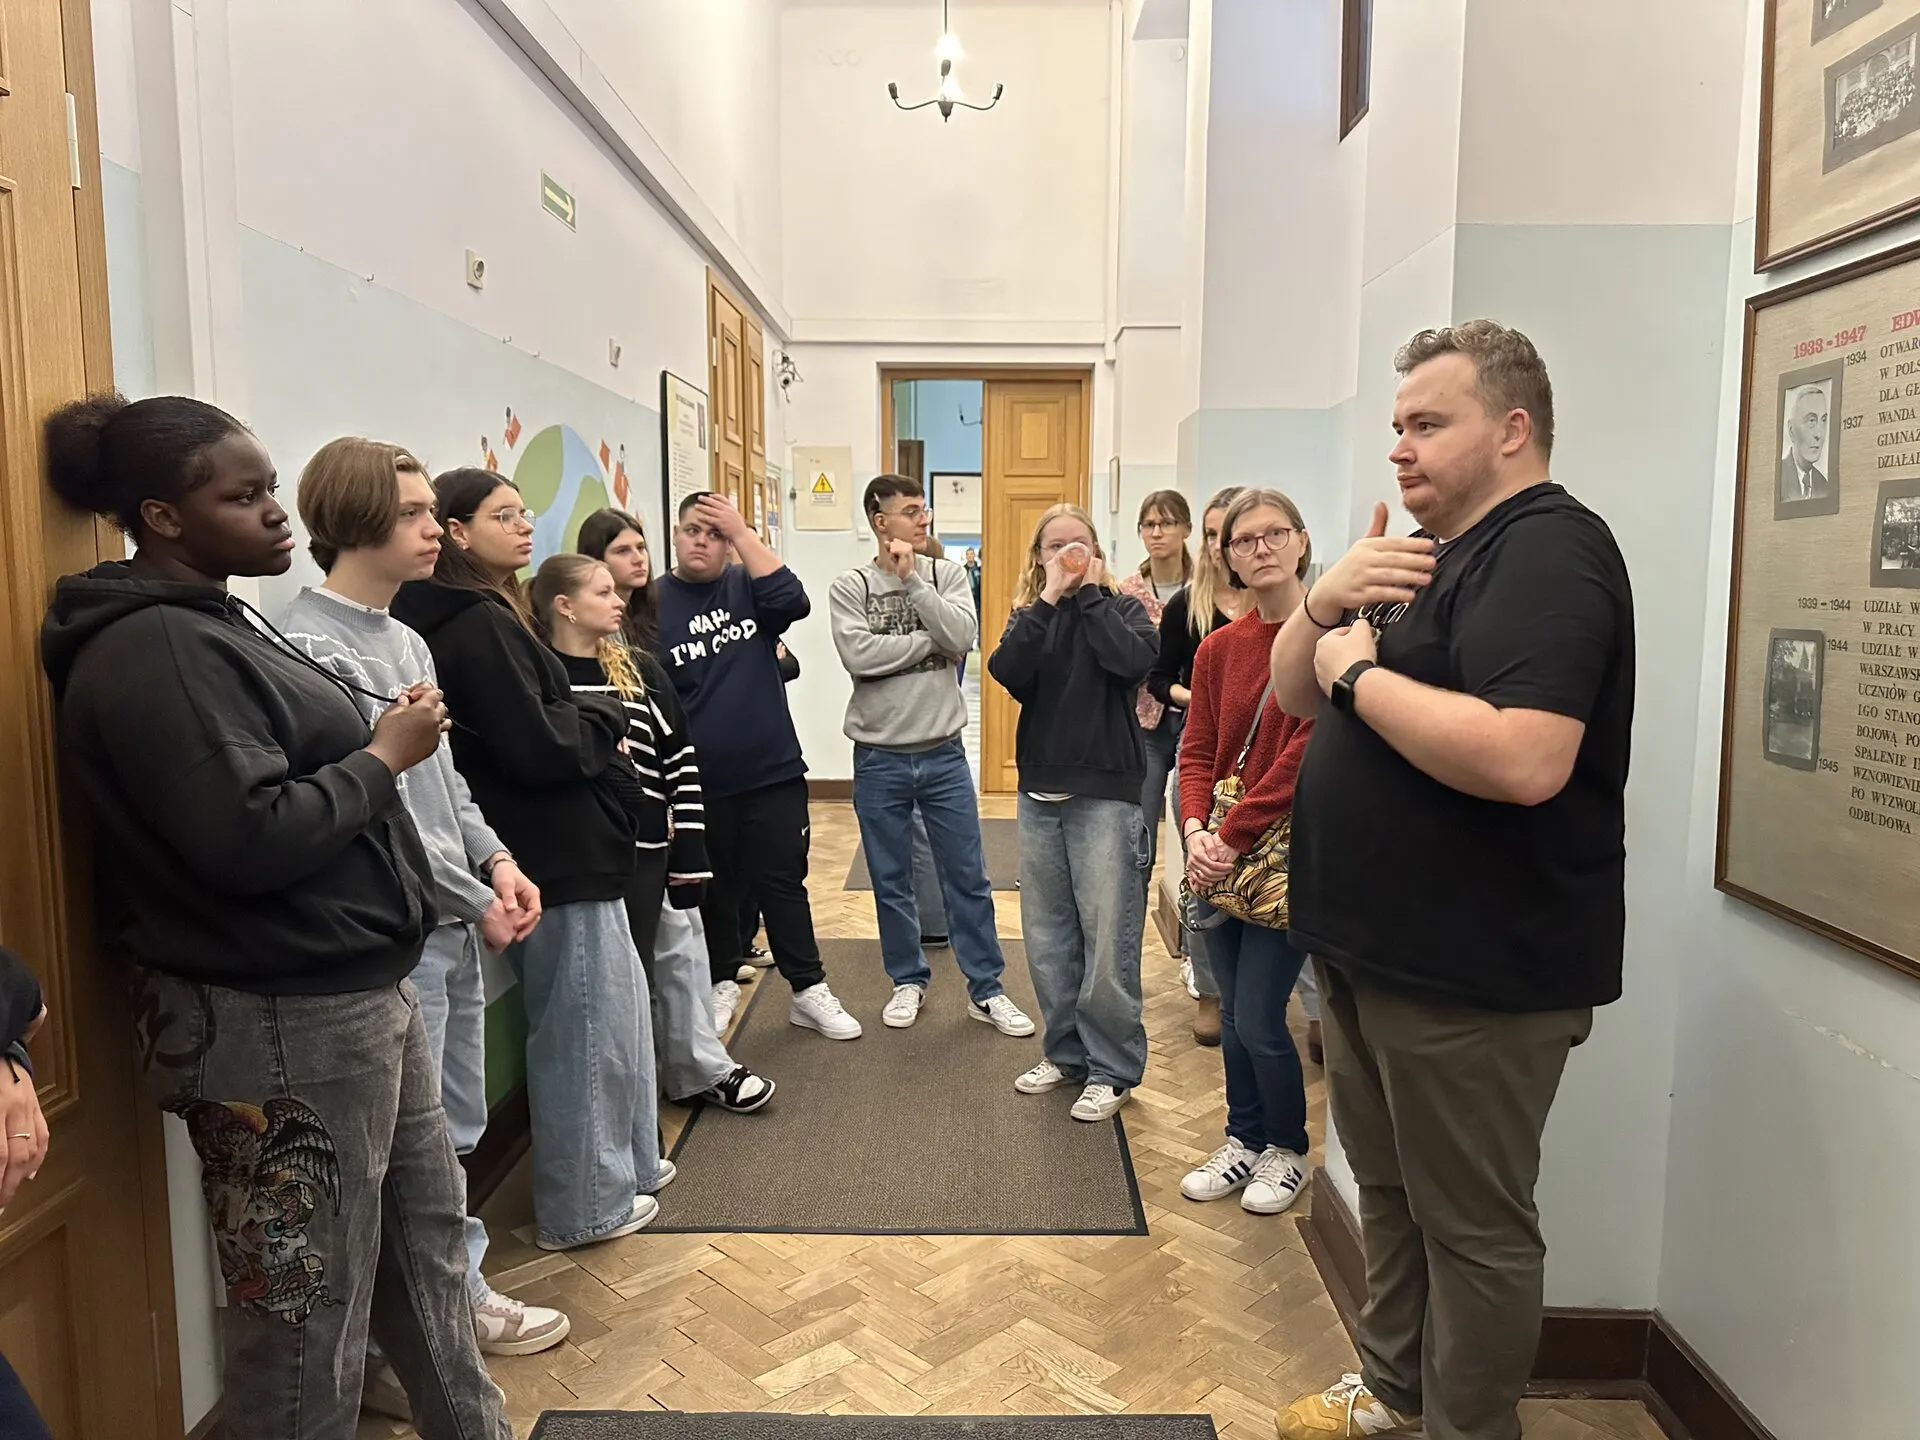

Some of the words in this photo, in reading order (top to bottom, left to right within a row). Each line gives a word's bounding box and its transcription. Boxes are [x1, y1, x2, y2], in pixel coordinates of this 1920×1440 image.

[1846, 350, 1867, 367] 1934
[1880, 336, 1920, 359] OTWAR
[1880, 367, 1890, 380] W
[1879, 388, 1900, 403] DLA
[1843, 415, 1864, 430] 1937
[1878, 407, 1916, 425] WANDA
[1798, 597, 1818, 609] 1939
[1829, 599, 1851, 611] 1944
[1864, 600, 1902, 613] UDZIAŁ
[1863, 621, 1872, 633] W
[1878, 622, 1915, 637] PRACY
[669, 640, 707, 667] I'M
[1827, 639, 1848, 651] 1944
[1862, 642, 1902, 657] UDZIAŁ
[1908, 646, 1918, 659] W
[1858, 683, 1907, 701] UCZNIÓW
[1856, 725, 1897, 747] BOJOWĄ
[1819, 758, 1839, 772] 1945
[1854, 745, 1907, 767] SPALENIE
[1851, 786, 1865, 800] PO
[1872, 791, 1920, 815] WYZWOL
[1848, 806, 1911, 834] ODBUDOWA
